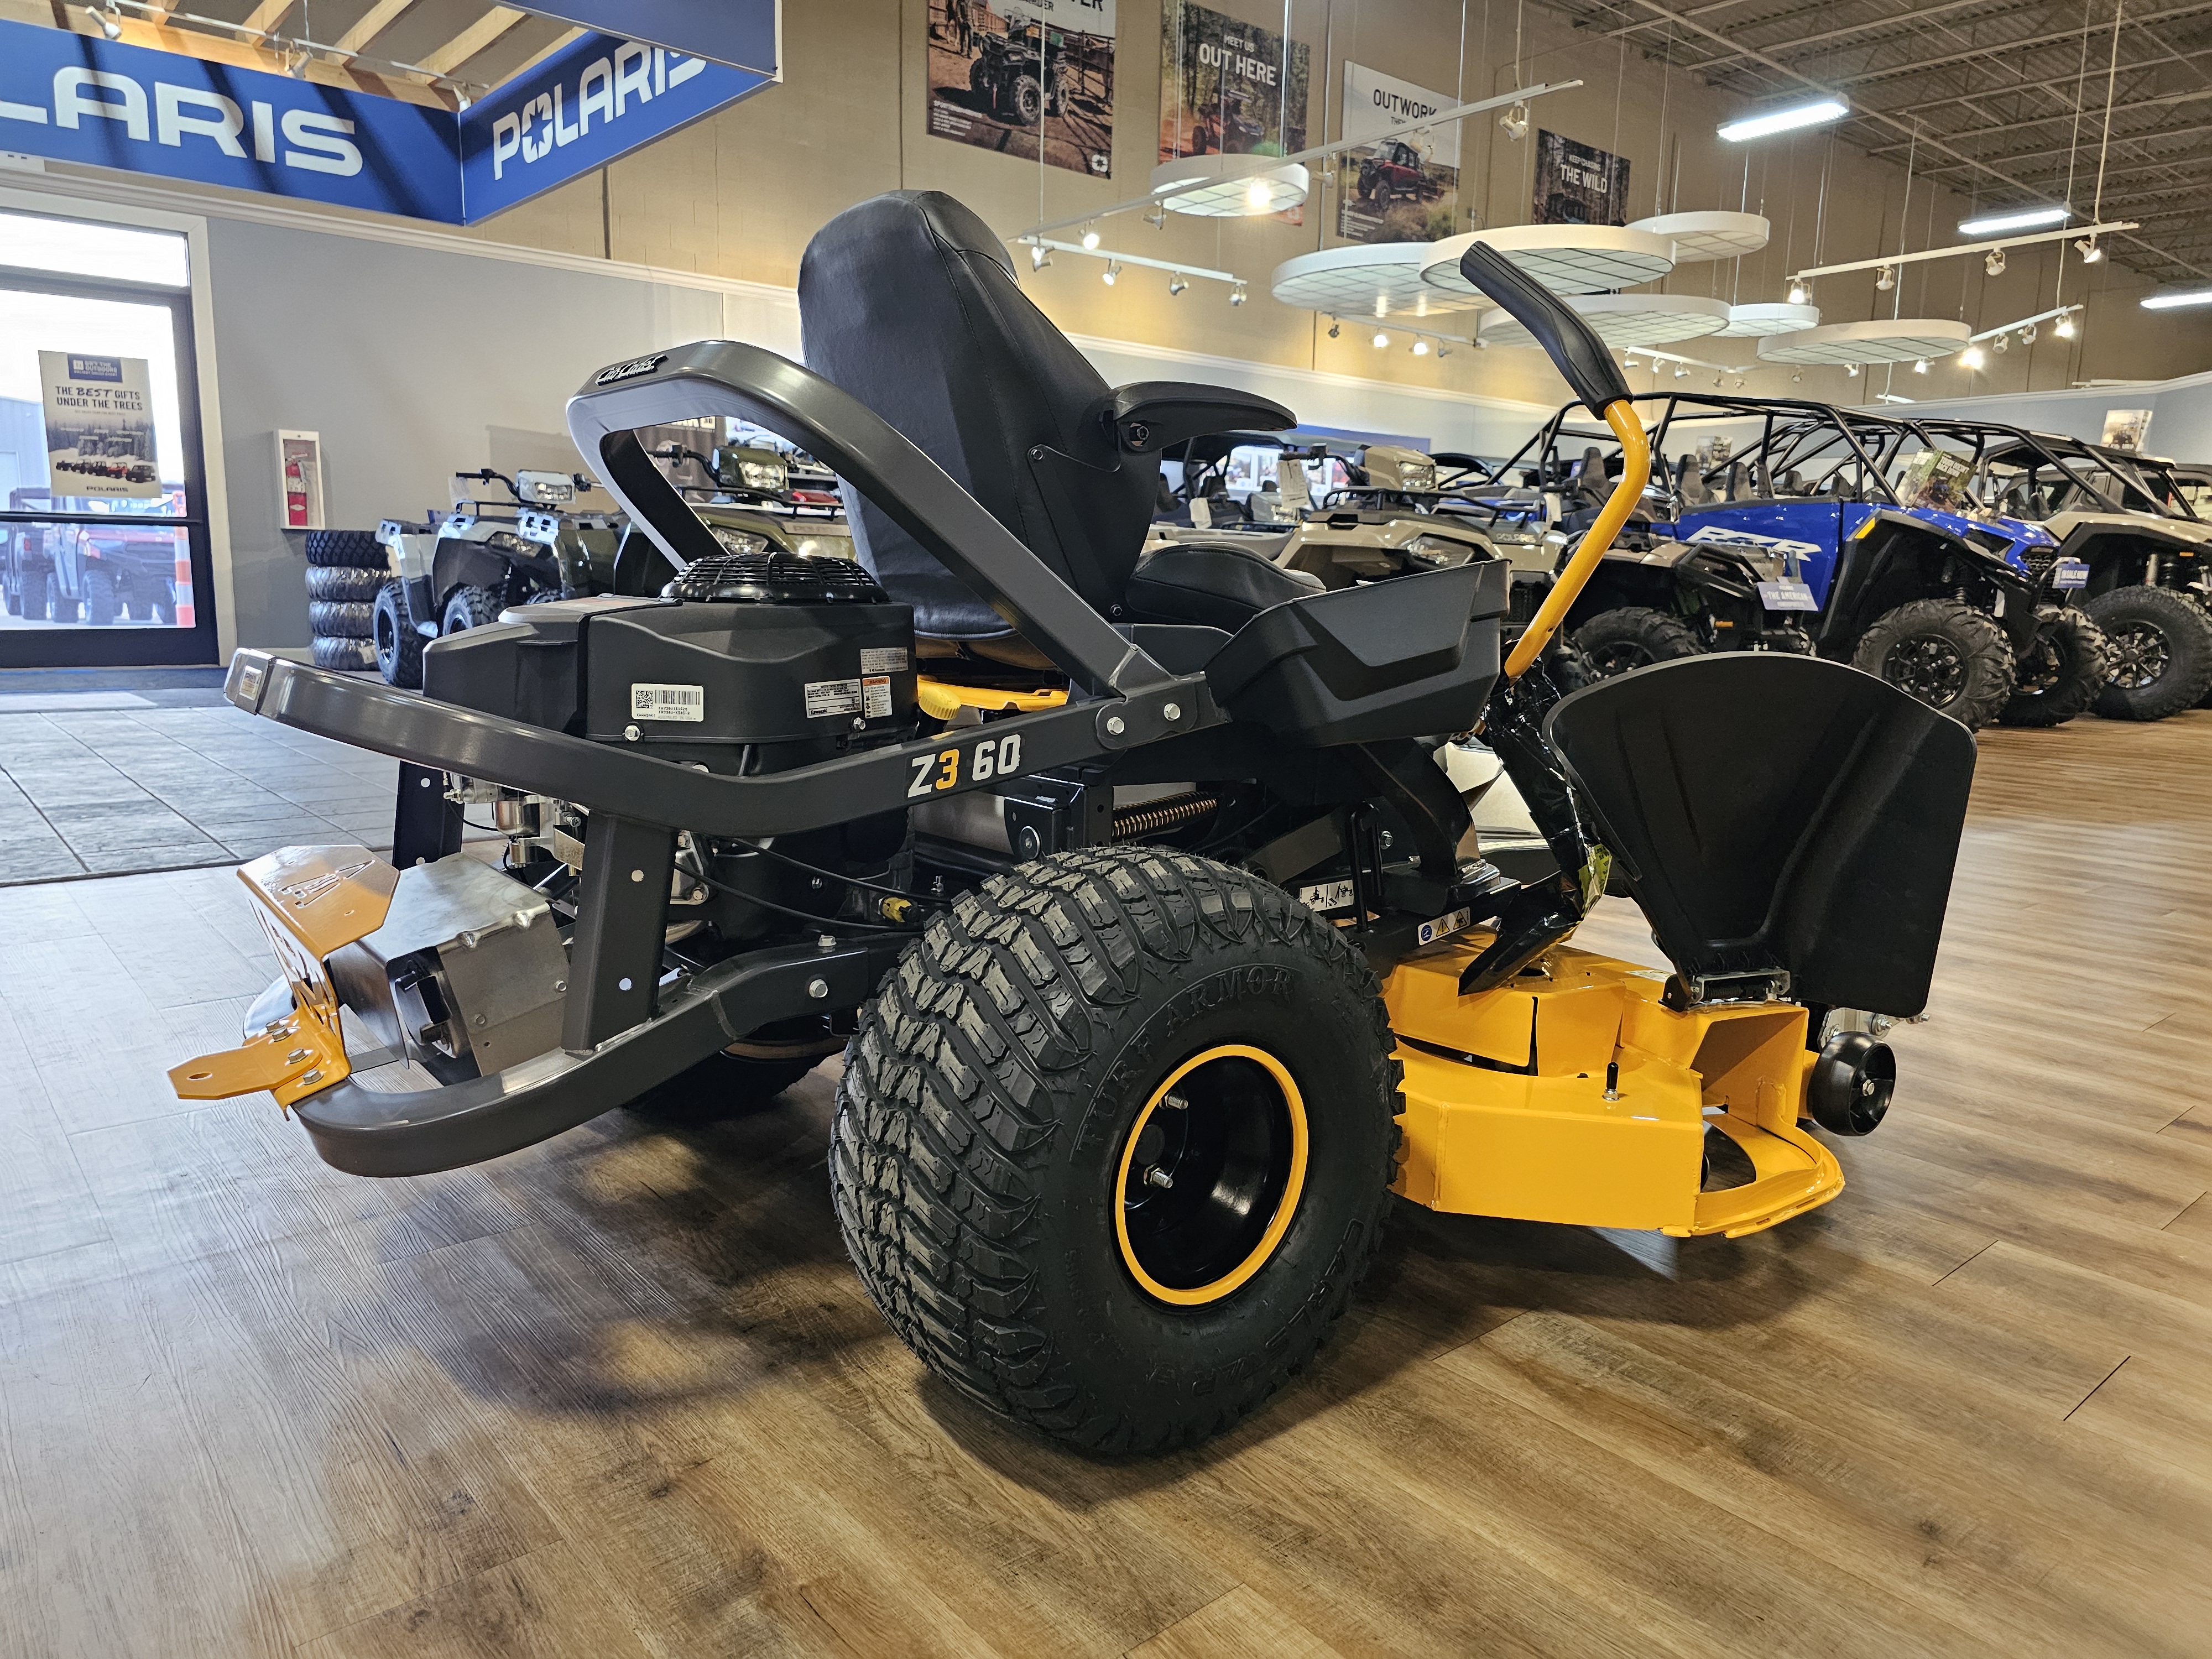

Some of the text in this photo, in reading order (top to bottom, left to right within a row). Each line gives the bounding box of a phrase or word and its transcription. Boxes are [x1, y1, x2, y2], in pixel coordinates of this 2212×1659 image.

[1224, 34, 1255, 53] MEET US
[1199, 43, 1276, 86] OUT HERE
[1373, 88, 1437, 118] OUTWORK
[1560, 164, 1608, 194] THE WILD
[55, 386, 140, 400] THE BEST GIFTS
[56, 397, 143, 410] UNDER THE TREES
[1686, 525, 1822, 562] RZR
[907, 734, 1021, 798] Z3 60
[1166, 965, 1295, 1037] ARMOR
